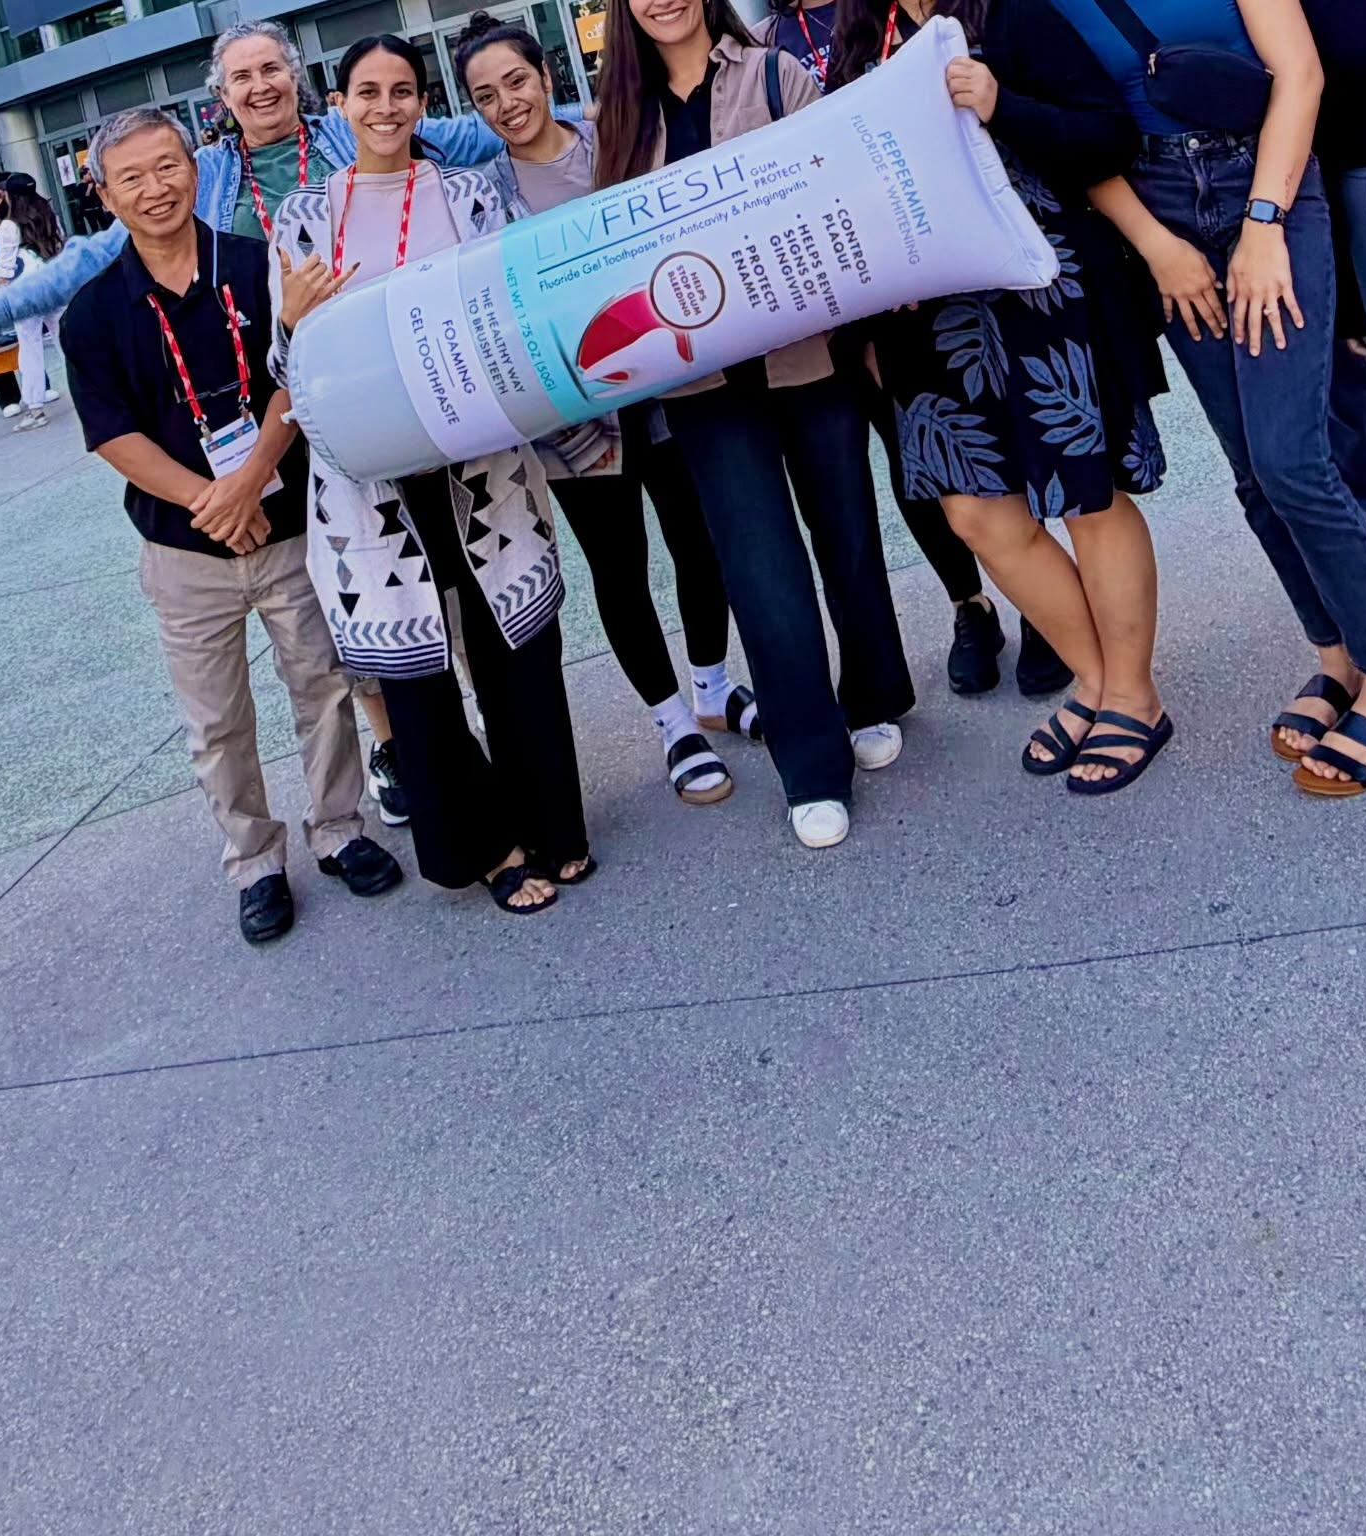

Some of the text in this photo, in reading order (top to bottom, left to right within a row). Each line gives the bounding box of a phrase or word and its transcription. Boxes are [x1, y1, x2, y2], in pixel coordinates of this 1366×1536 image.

[750, 160, 778, 177] GUM
[754, 162, 803, 189] PROTECT
[851, 115, 888, 173] FLUORIDE
[886, 184, 920, 265] WHITENING
[877, 130, 932, 237] PEPPERMINT
[539, 179, 809, 292] Fluoride Gel Toothpaste For Anticavity & Antigingivitis
[783, 228, 818, 297] SIGNS OF
[797, 223, 823, 269] HELPS
[822, 213, 852, 273] PLAQUE
[837, 208, 871, 285] CONTROLS
[506, 267, 518, 288] NET
[511, 290, 524, 309] WT
[667, 270, 692, 317] BLEEDING
[676, 264, 703, 316] STOP GUM
[690, 271, 707, 302] HELPS
[731, 249, 762, 309] ENAMEL
[745, 244, 780, 313] PROTECTS
[769, 234, 808, 312] GINGIVITIS
[468, 298, 510, 395] TO BRUSH TEETH
[480, 285, 526, 394] THE HEALTHY WAY
[517, 313, 533, 338] 175
[527, 340, 542, 361] OZ
[410, 307, 461, 425] GEL TOOTHPASTE
[442, 319, 476, 394] FOAMING
